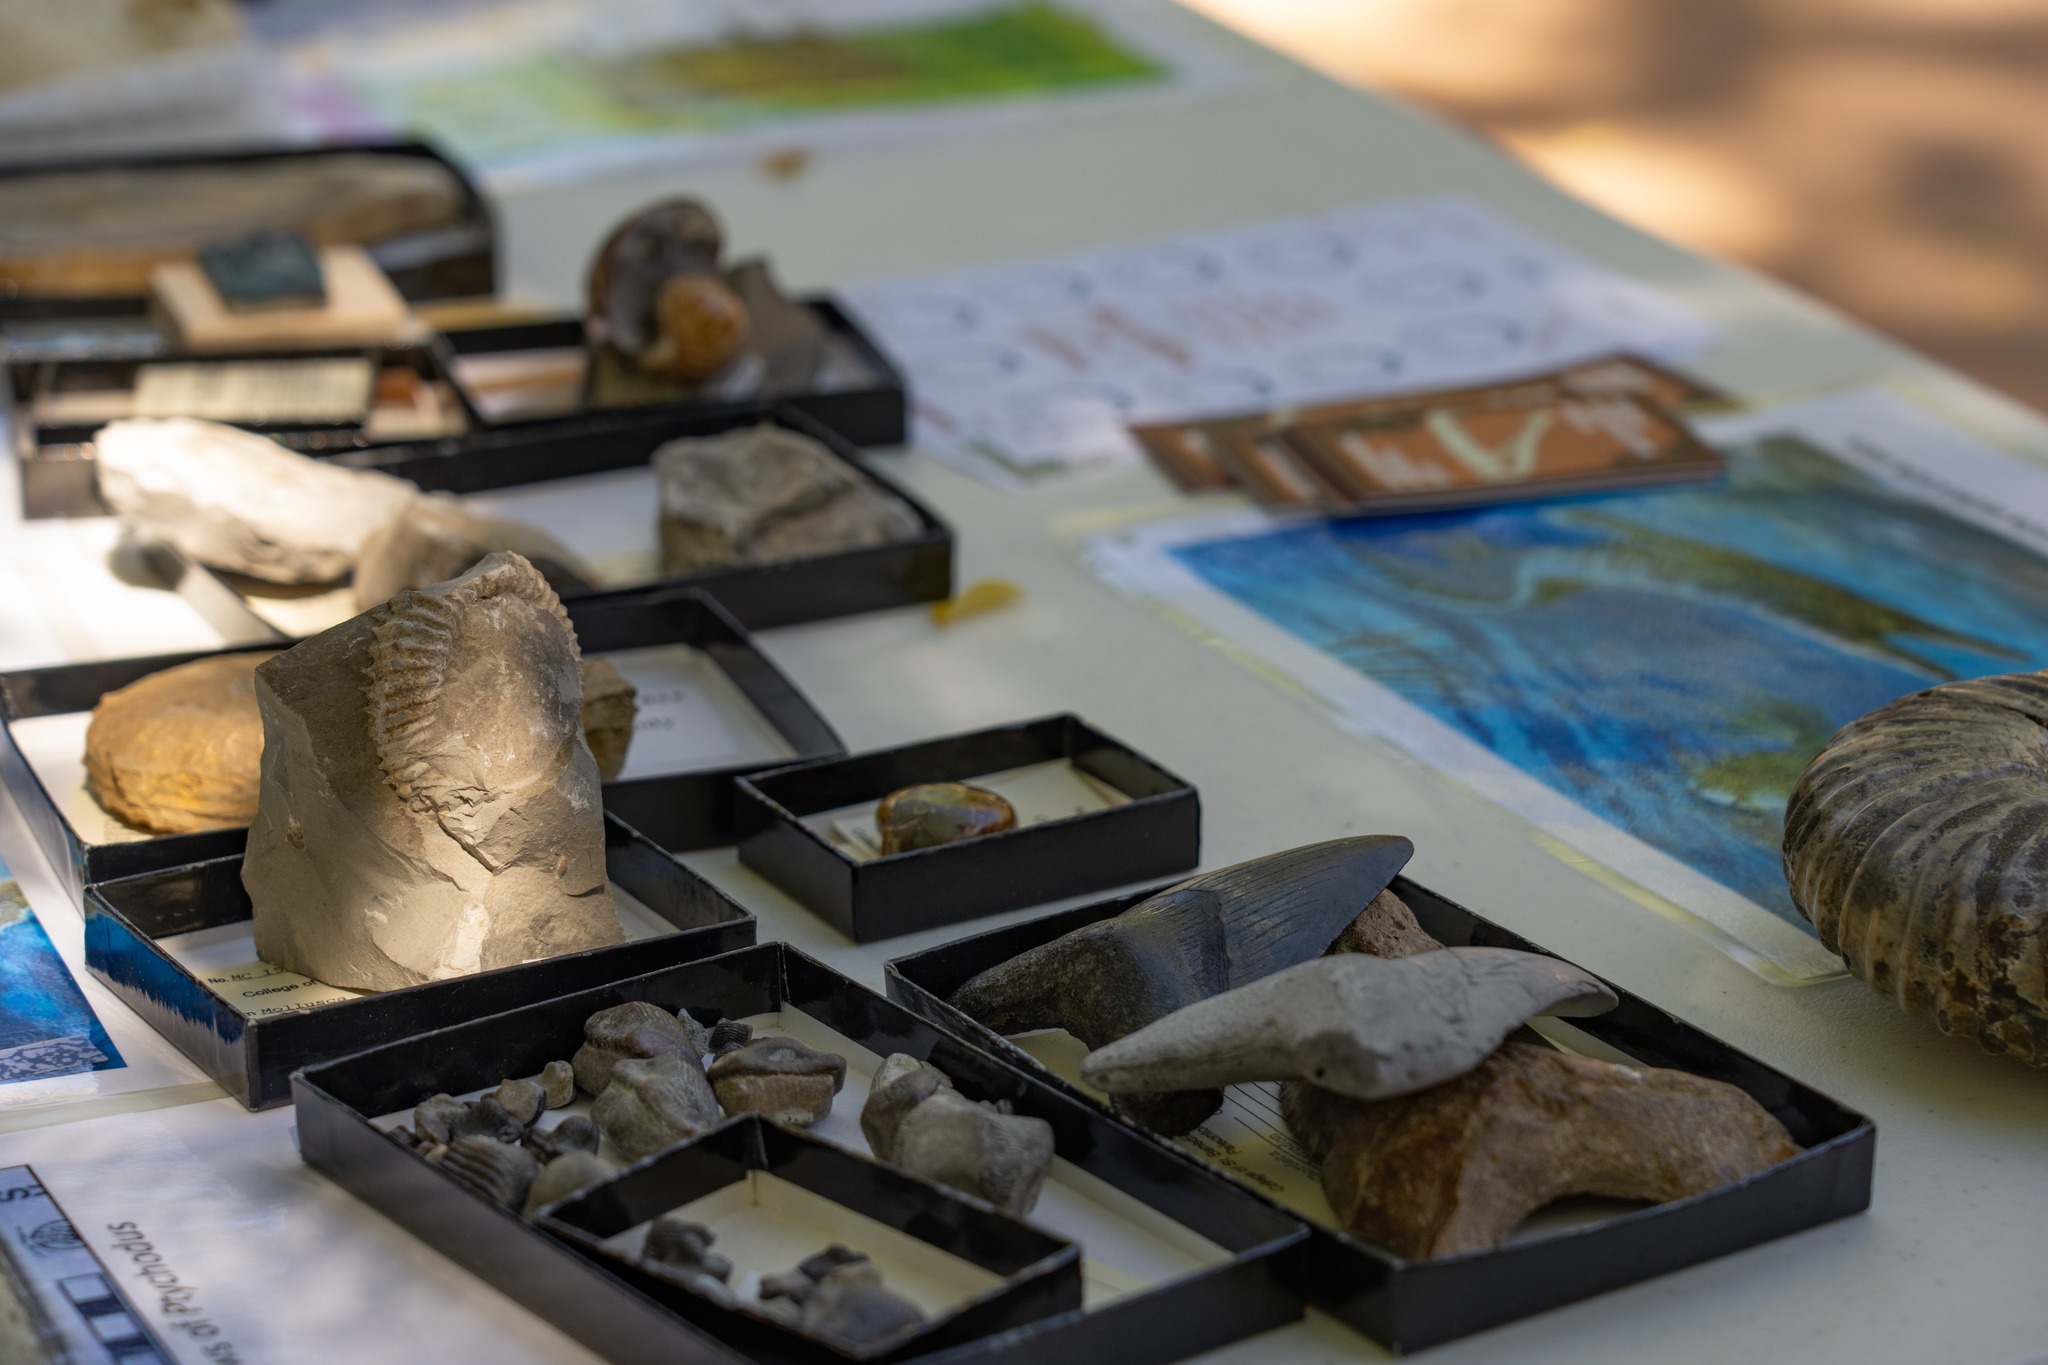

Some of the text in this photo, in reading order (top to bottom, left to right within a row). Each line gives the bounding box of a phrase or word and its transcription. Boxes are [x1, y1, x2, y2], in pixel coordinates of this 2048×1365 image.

[242, 979, 317, 998] College of
[261, 996, 346, 1015] Mollusca
[171, 1319, 221, 1338] of
